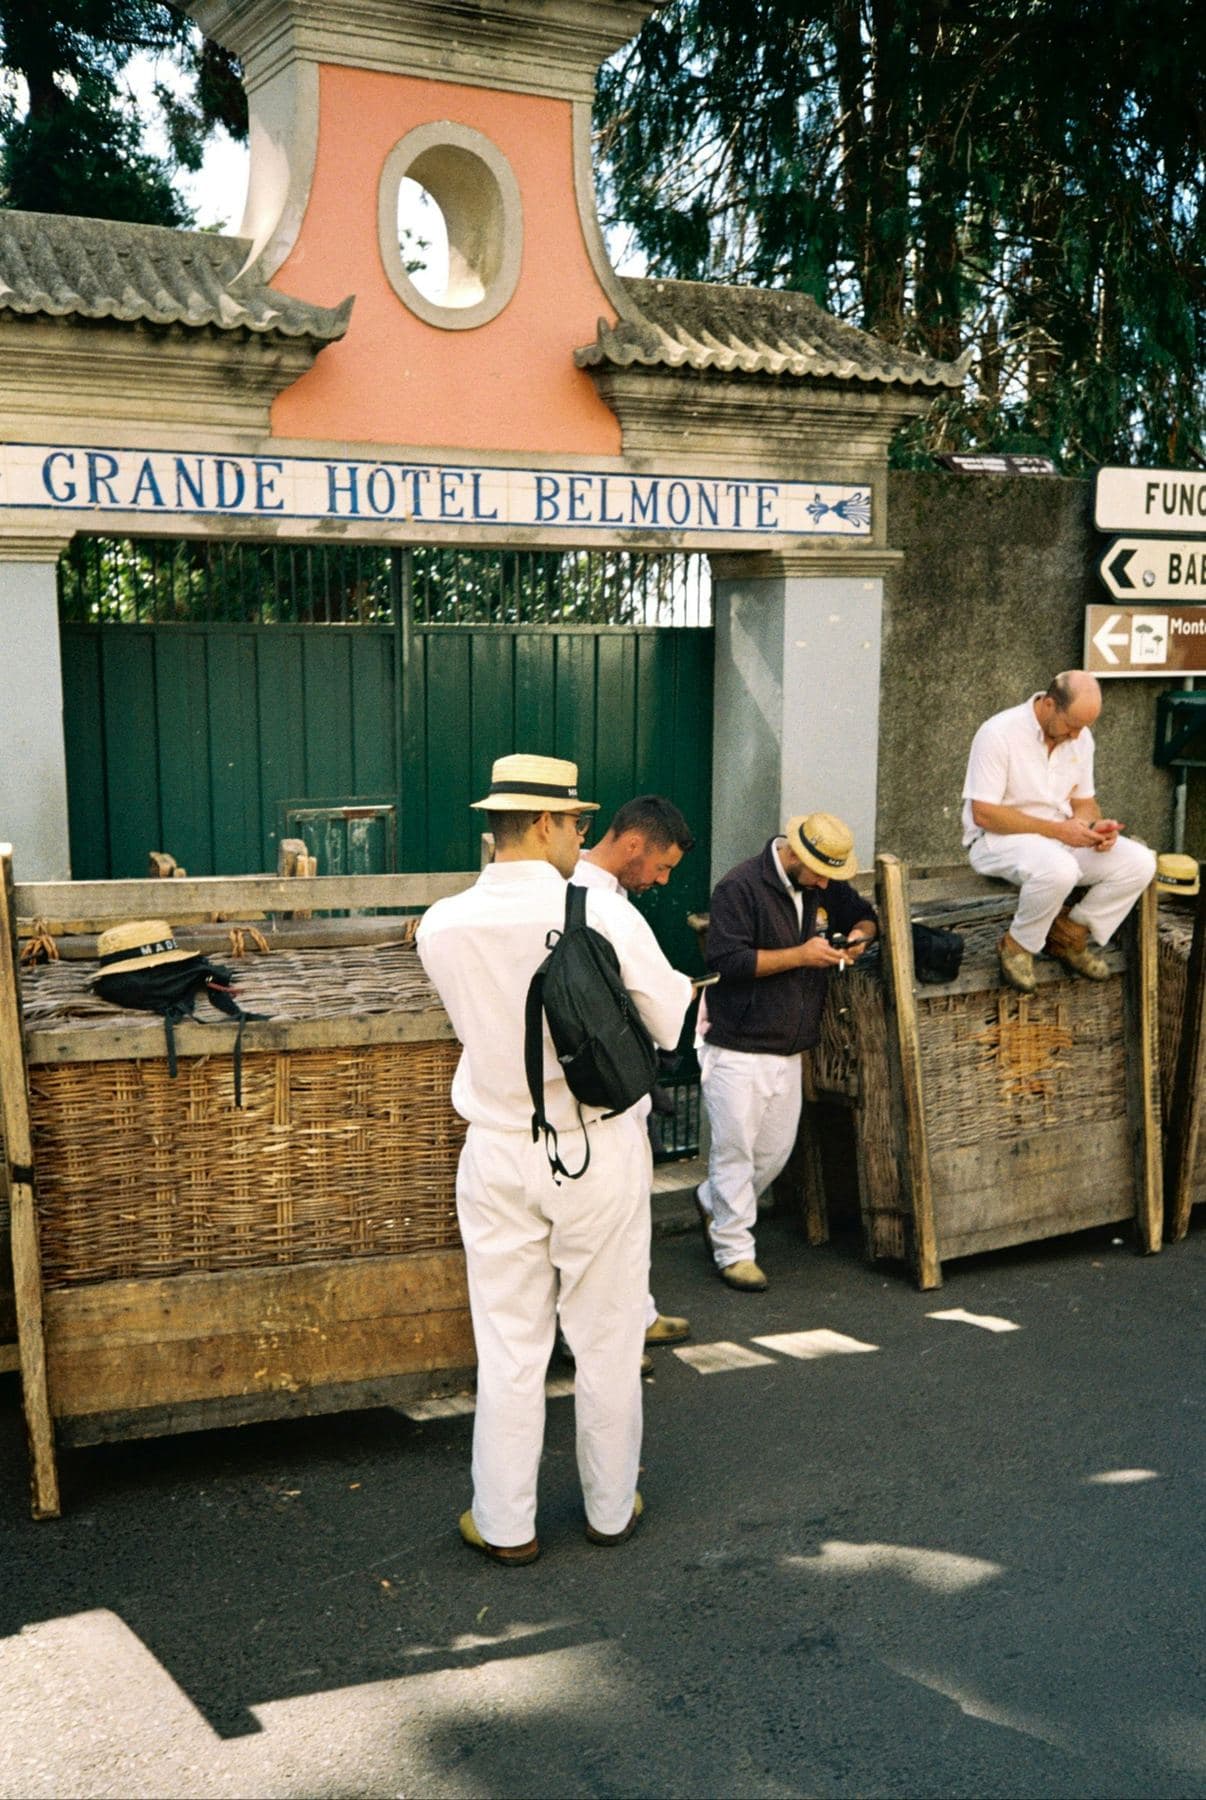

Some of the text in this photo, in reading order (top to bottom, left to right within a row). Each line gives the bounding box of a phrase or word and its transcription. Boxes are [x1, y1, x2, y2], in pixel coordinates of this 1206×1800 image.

[42, 451, 780, 529] GRANDE HOTEL BELMONTE
[1170, 618, 1206, 636] Mont
